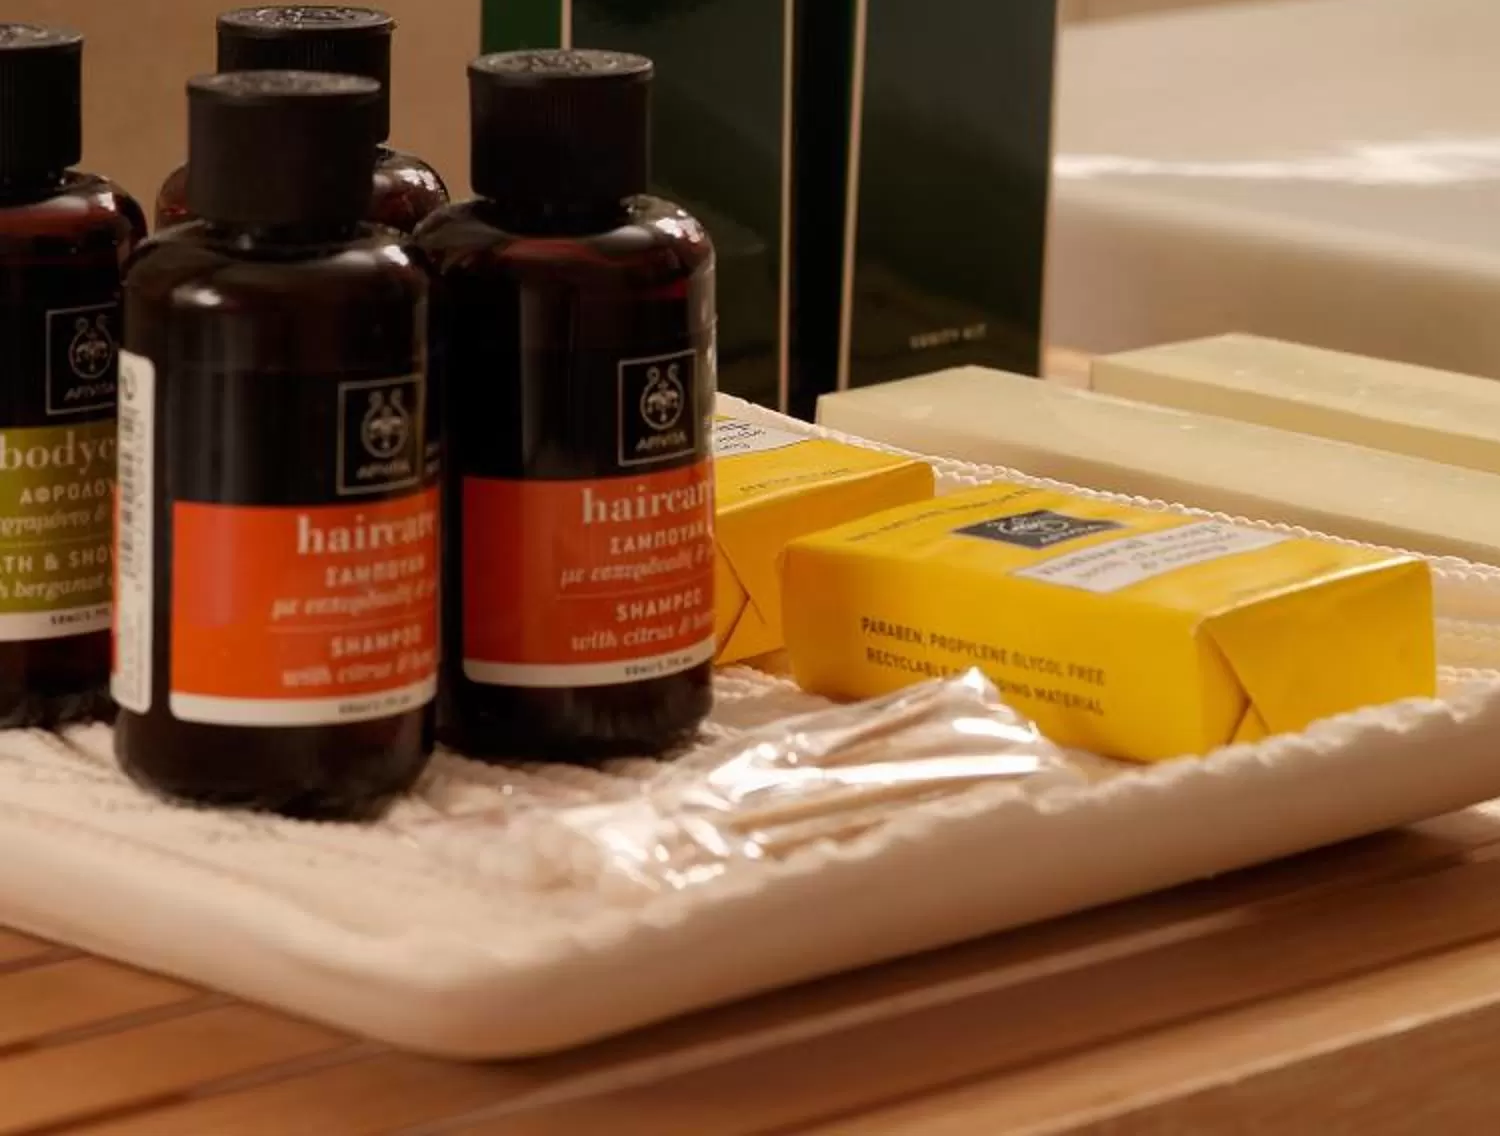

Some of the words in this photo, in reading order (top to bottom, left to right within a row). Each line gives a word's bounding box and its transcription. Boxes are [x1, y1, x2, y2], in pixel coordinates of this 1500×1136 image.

[615, 586, 703, 623] SHAMPOO
[571, 629, 618, 651] with
[623, 624, 676, 647] citrus
[861, 616, 927, 649] PARABEN,
[930, 632, 1007, 665] PROPYLENE
[1012, 651, 1064, 678] GLYCOL
[1068, 663, 1105, 687] FREE
[866, 647, 948, 677] RECYCLABLE
[1034, 686, 1105, 716] MATERIAL
